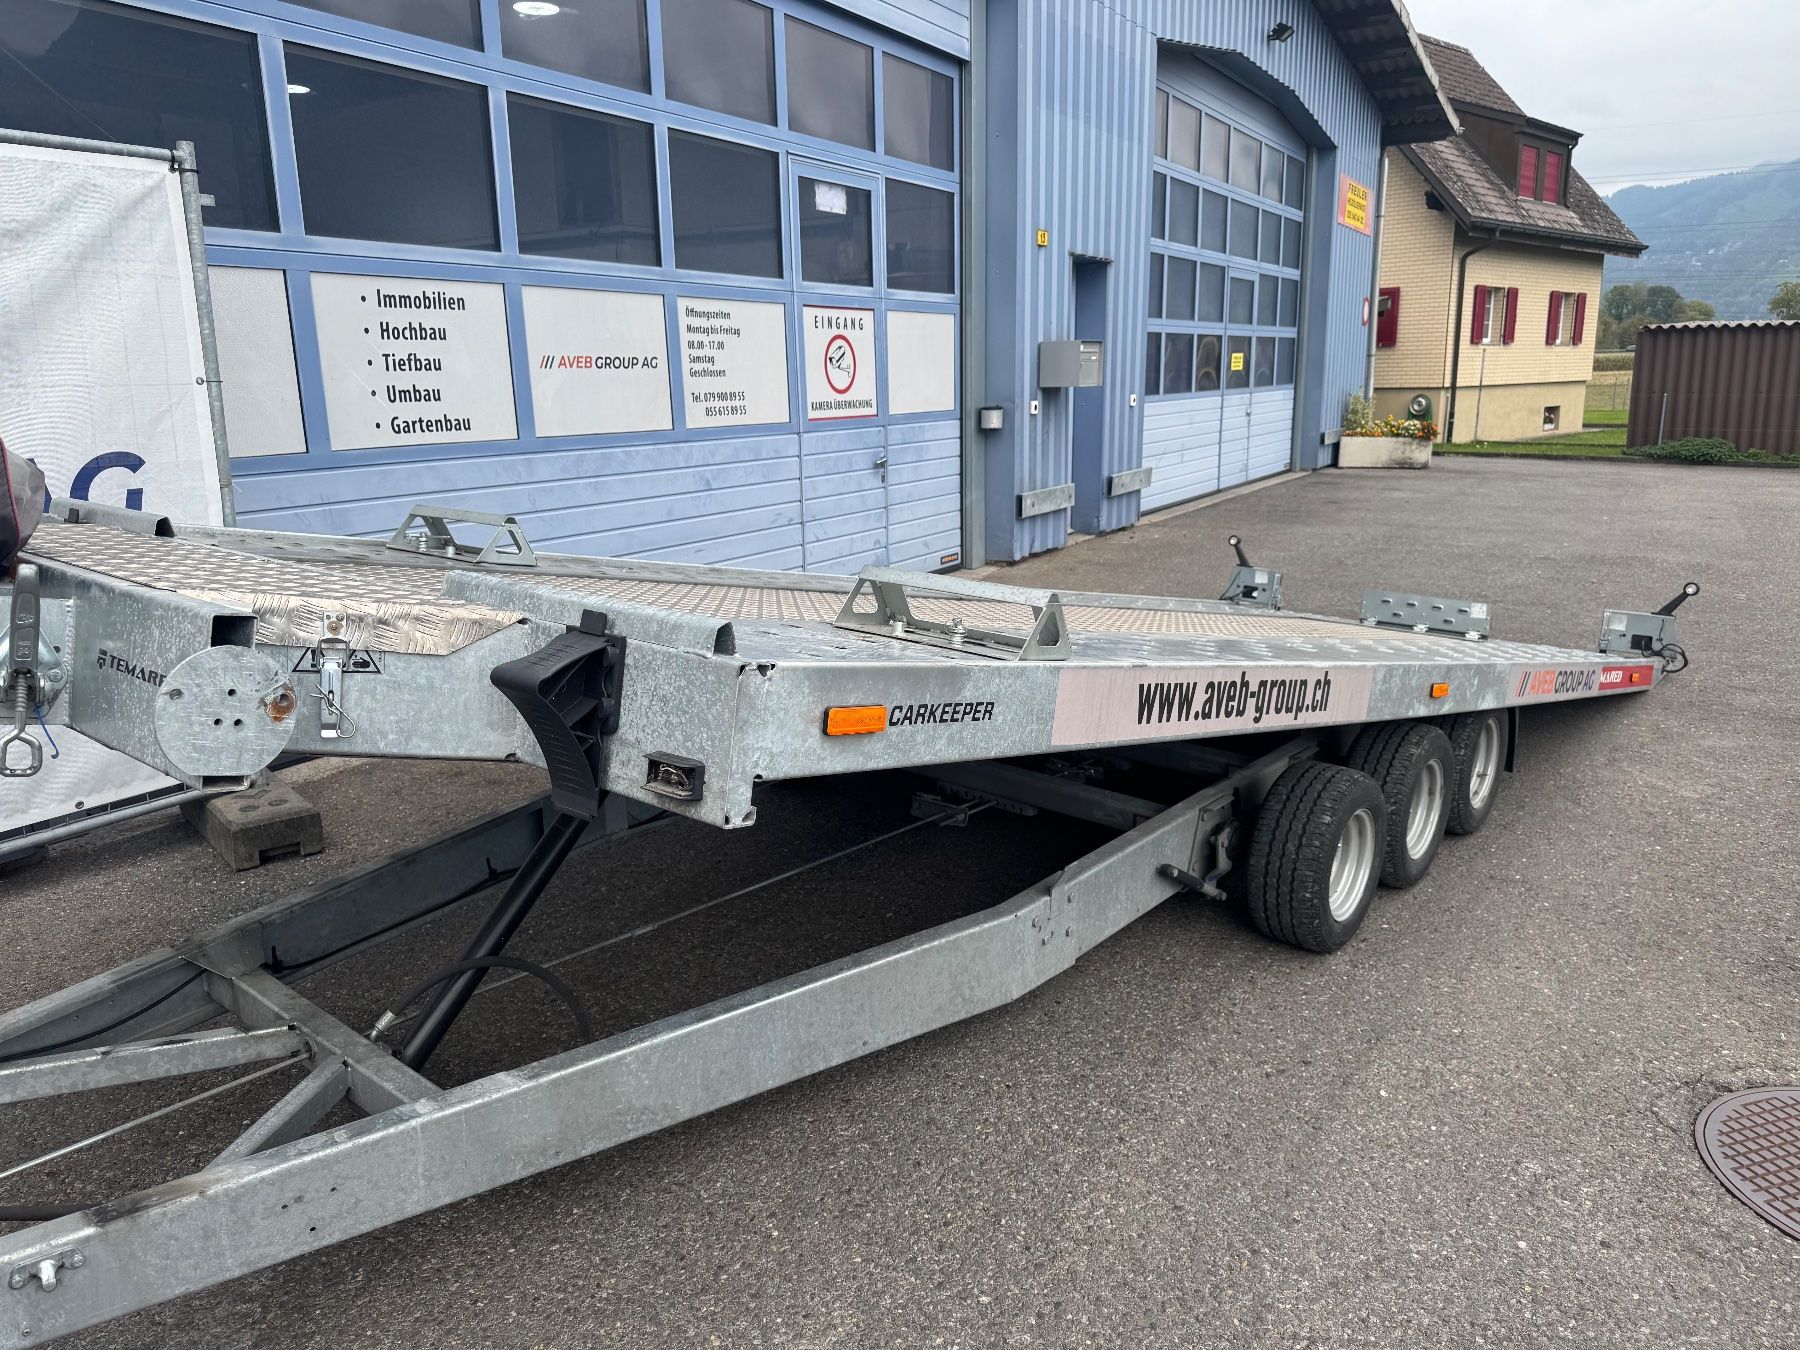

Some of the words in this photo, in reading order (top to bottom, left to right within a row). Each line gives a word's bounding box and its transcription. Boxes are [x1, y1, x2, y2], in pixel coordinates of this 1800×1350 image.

[376, 289, 466, 311] Immobilien
[685, 305, 731, 321] Öffnungszeiten
[379, 321, 447, 341] Hochbau
[686, 323, 710, 337] Montag
[710, 324, 719, 335] bis
[719, 325, 741, 338] Freitag
[814, 315, 864, 331] EINGANG
[687, 340, 704, 350] 08.00
[708, 340, 725, 351] 17.00
[382, 353, 442, 372] Tiefbau
[558, 355, 593, 369] AVEB
[595, 356, 639, 370] GROUP
[641, 356, 658, 370] AG
[688, 353, 715, 366] Samstag
[689, 367, 726, 378] Geschlossen
[386, 384, 441, 403] Umbau
[737, 391, 746, 401] 55
[739, 404, 747, 415] 55
[811, 401, 833, 411] KAMERA
[833, 398, 873, 411] ÜBERWACHUNG
[390, 414, 471, 434] Gartenbau
[1530, 670, 1555, 696] AVEB
[1554, 670, 1584, 694] GROUP
[1583, 670, 1596, 691] AG
[1137, 670, 1331, 725] www.aveb-group.ch
[888, 701, 995, 727] CARKEEPER
